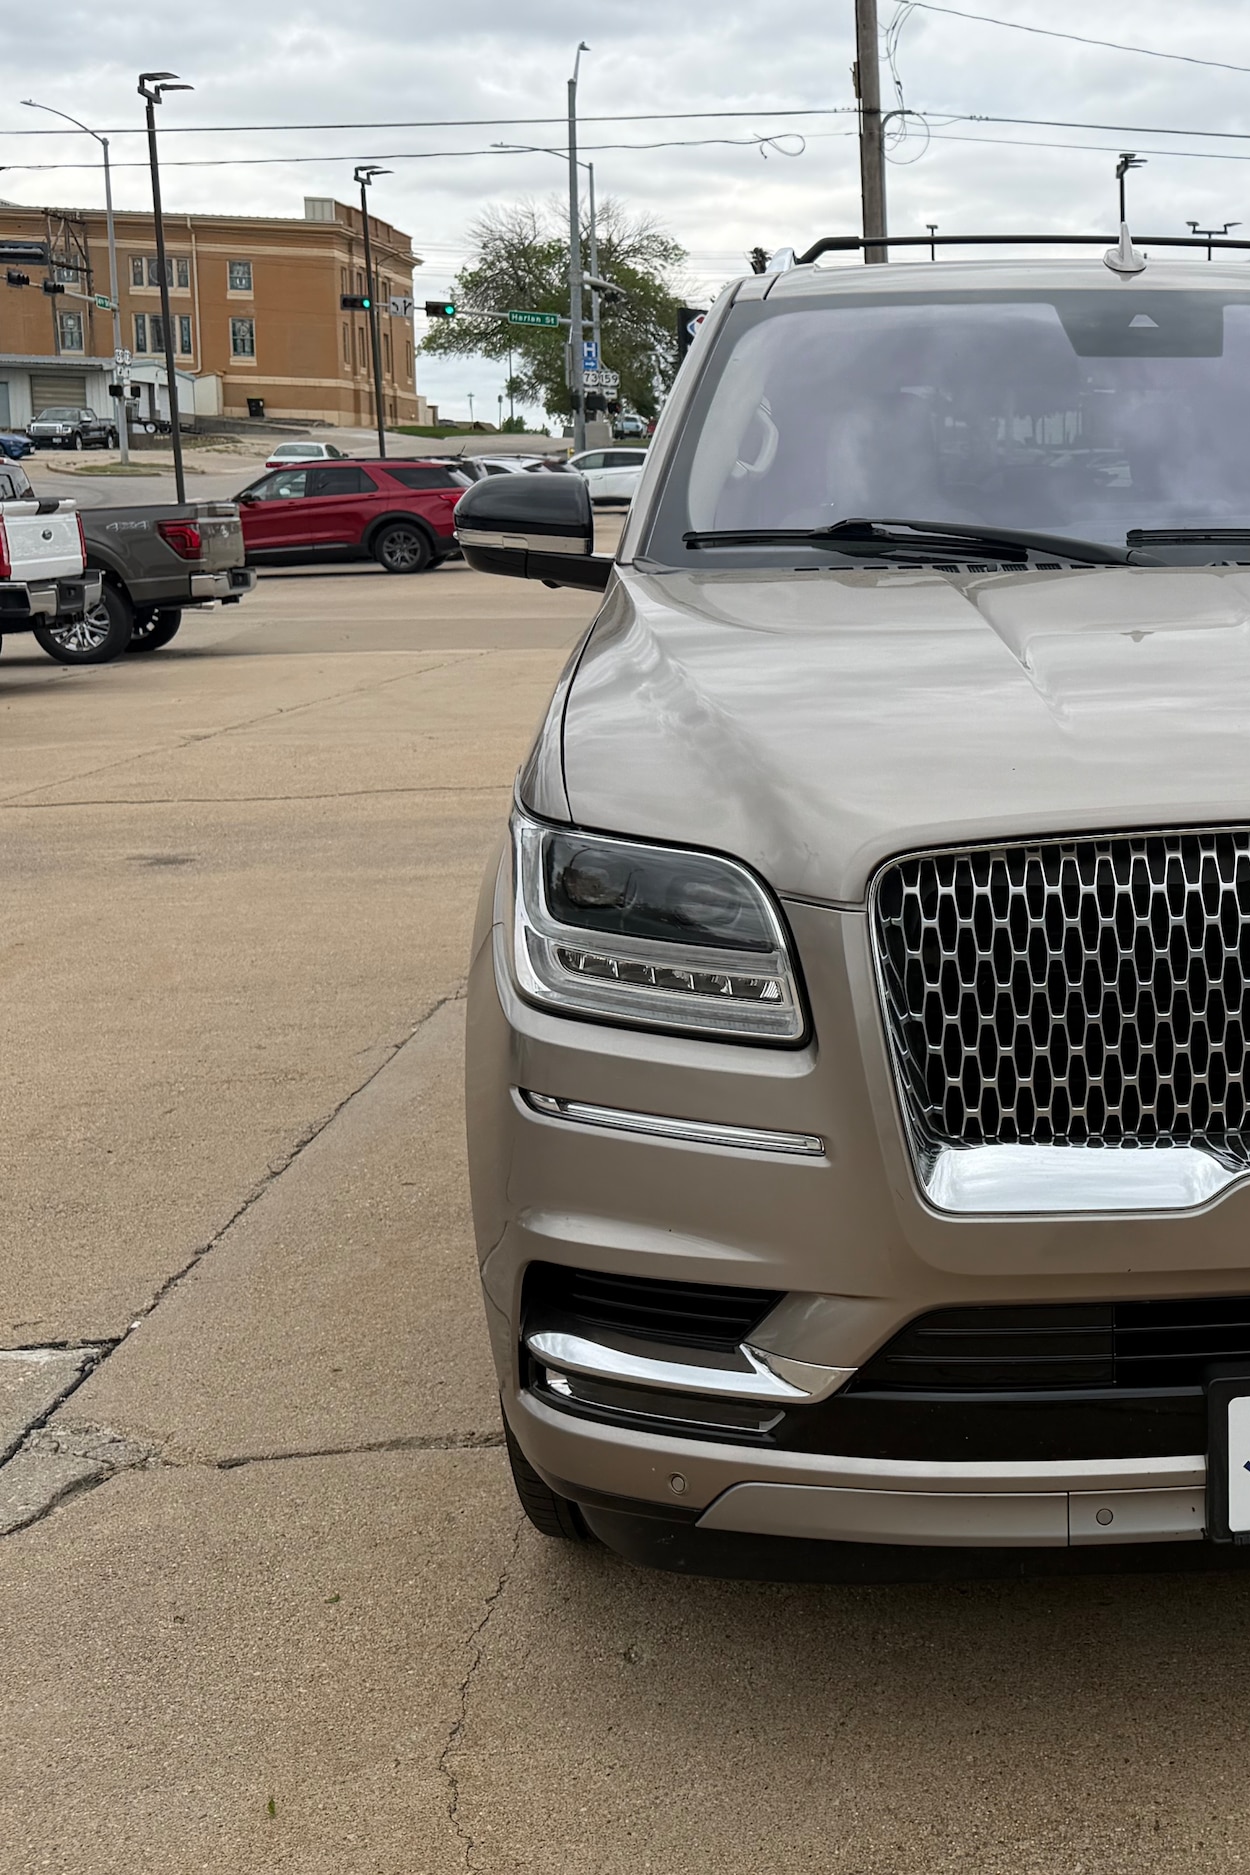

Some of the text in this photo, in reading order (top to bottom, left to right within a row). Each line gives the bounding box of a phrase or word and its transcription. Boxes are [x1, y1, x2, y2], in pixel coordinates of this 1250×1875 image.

[511, 313, 555, 324] Harlan St
[583, 342, 596, 358] H
[584, 373, 597, 383] 73
[600, 374, 618, 383] 159
